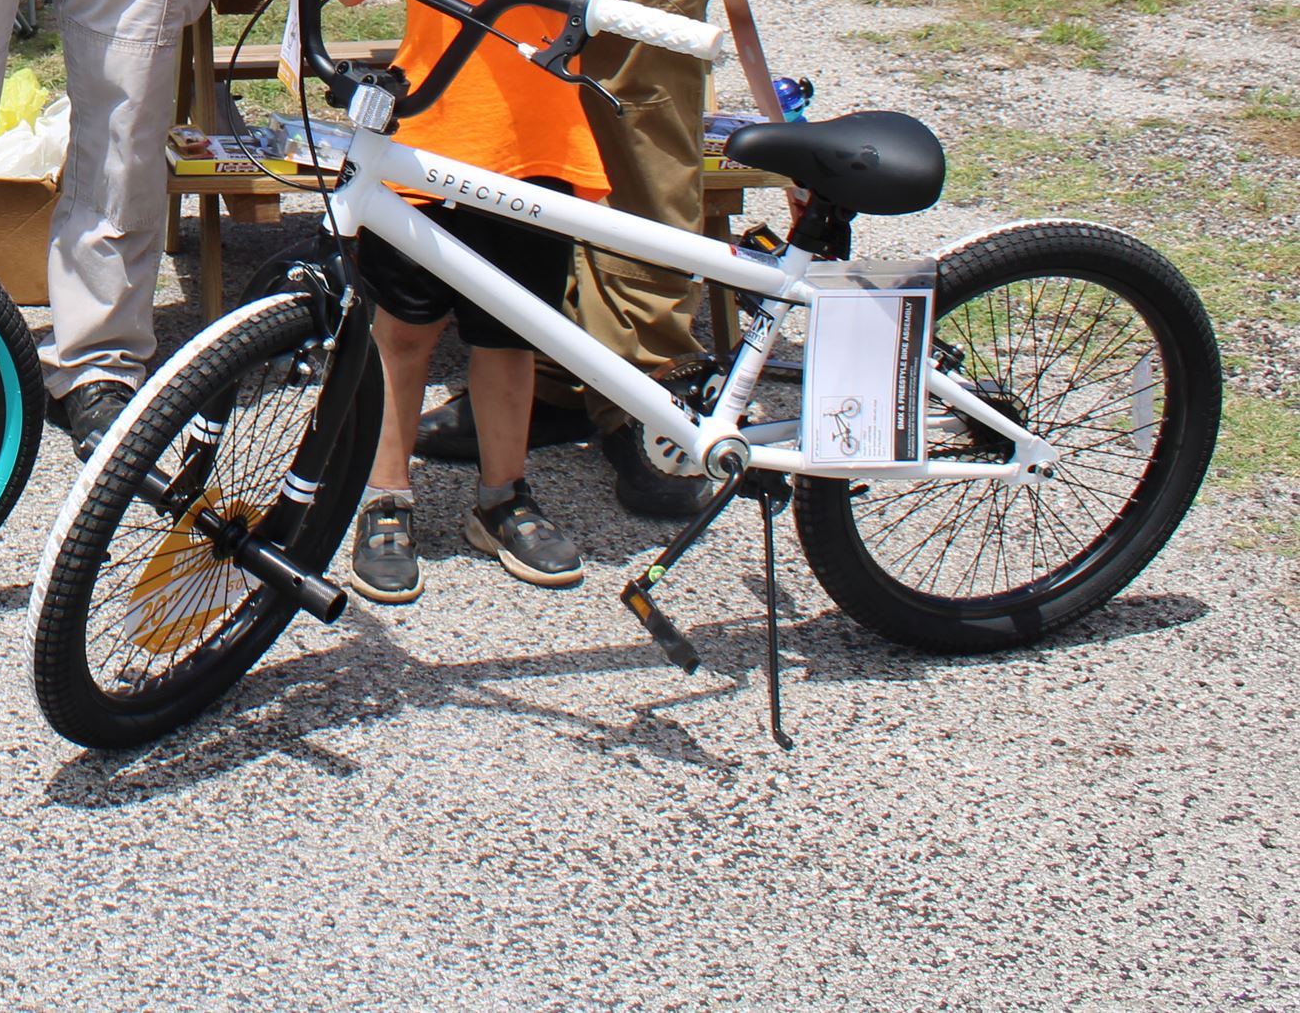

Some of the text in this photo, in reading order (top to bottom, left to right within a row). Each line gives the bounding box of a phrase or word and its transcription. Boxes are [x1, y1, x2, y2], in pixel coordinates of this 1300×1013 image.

[426, 168, 542, 218] SPECTOR
[903, 302, 912, 341] ASSEMBLY
[901, 341, 909, 359] BIKE
[897, 412, 905, 430] BMX
